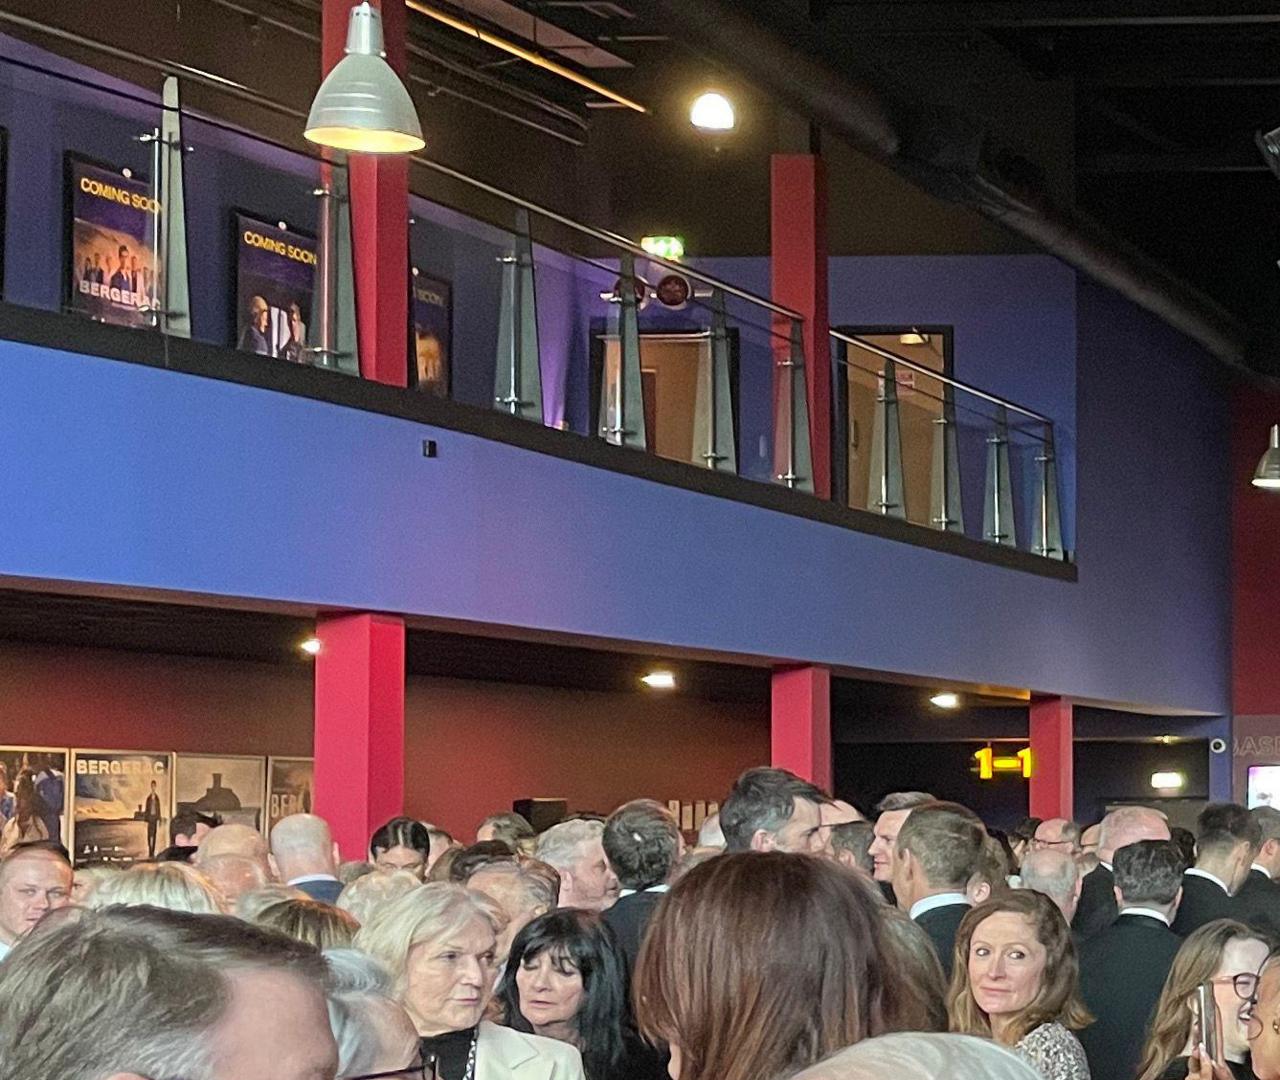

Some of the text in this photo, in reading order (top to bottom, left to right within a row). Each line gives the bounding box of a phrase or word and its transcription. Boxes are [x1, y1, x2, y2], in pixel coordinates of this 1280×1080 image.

[80, 178, 130, 206] COMING
[244, 231, 317, 265] COMING SOON
[76, 759, 165, 776] BERGERAC
